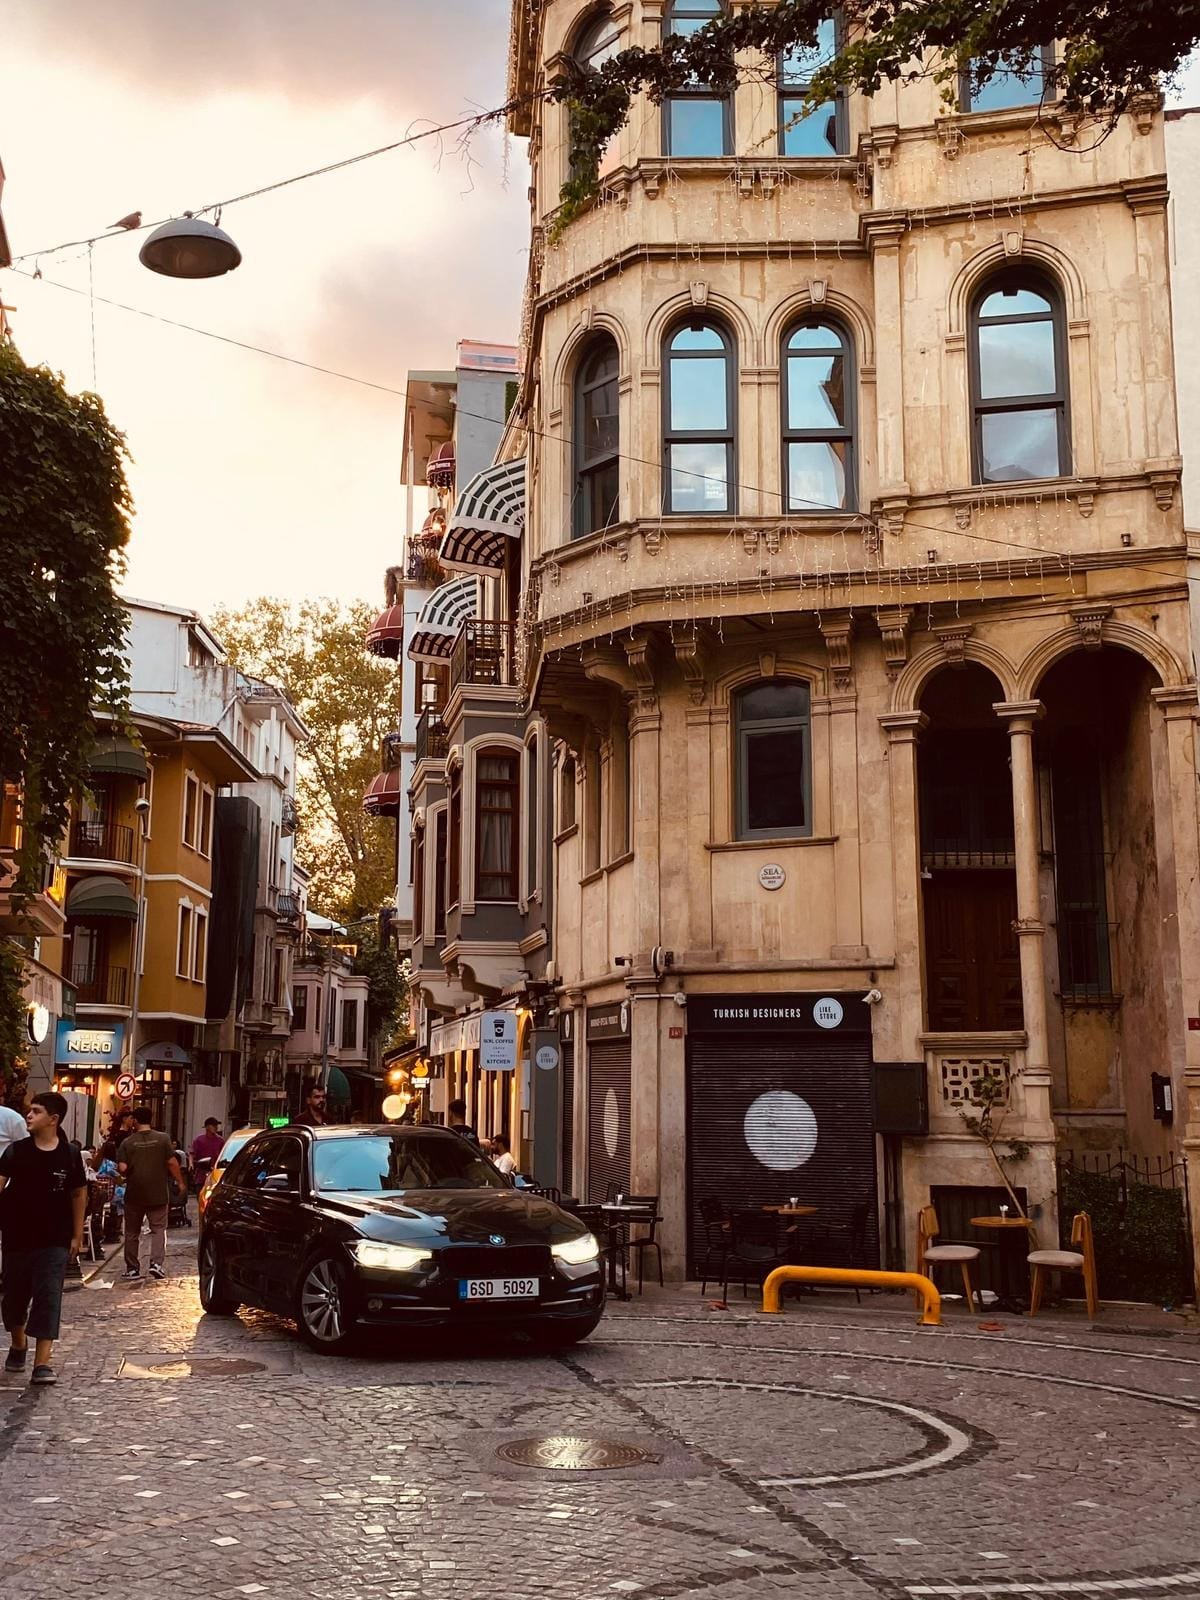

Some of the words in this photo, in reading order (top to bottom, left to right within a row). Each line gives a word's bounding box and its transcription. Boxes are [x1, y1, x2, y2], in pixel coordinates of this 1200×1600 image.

[763, 868, 780, 876] SEA
[713, 1008, 750, 1019] TURKISH
[752, 1008, 801, 1019] DESIGNERS
[67, 1040, 112, 1053] NERO
[470, 1281, 494, 1296] 6SD
[503, 1280, 534, 1295] 5092
